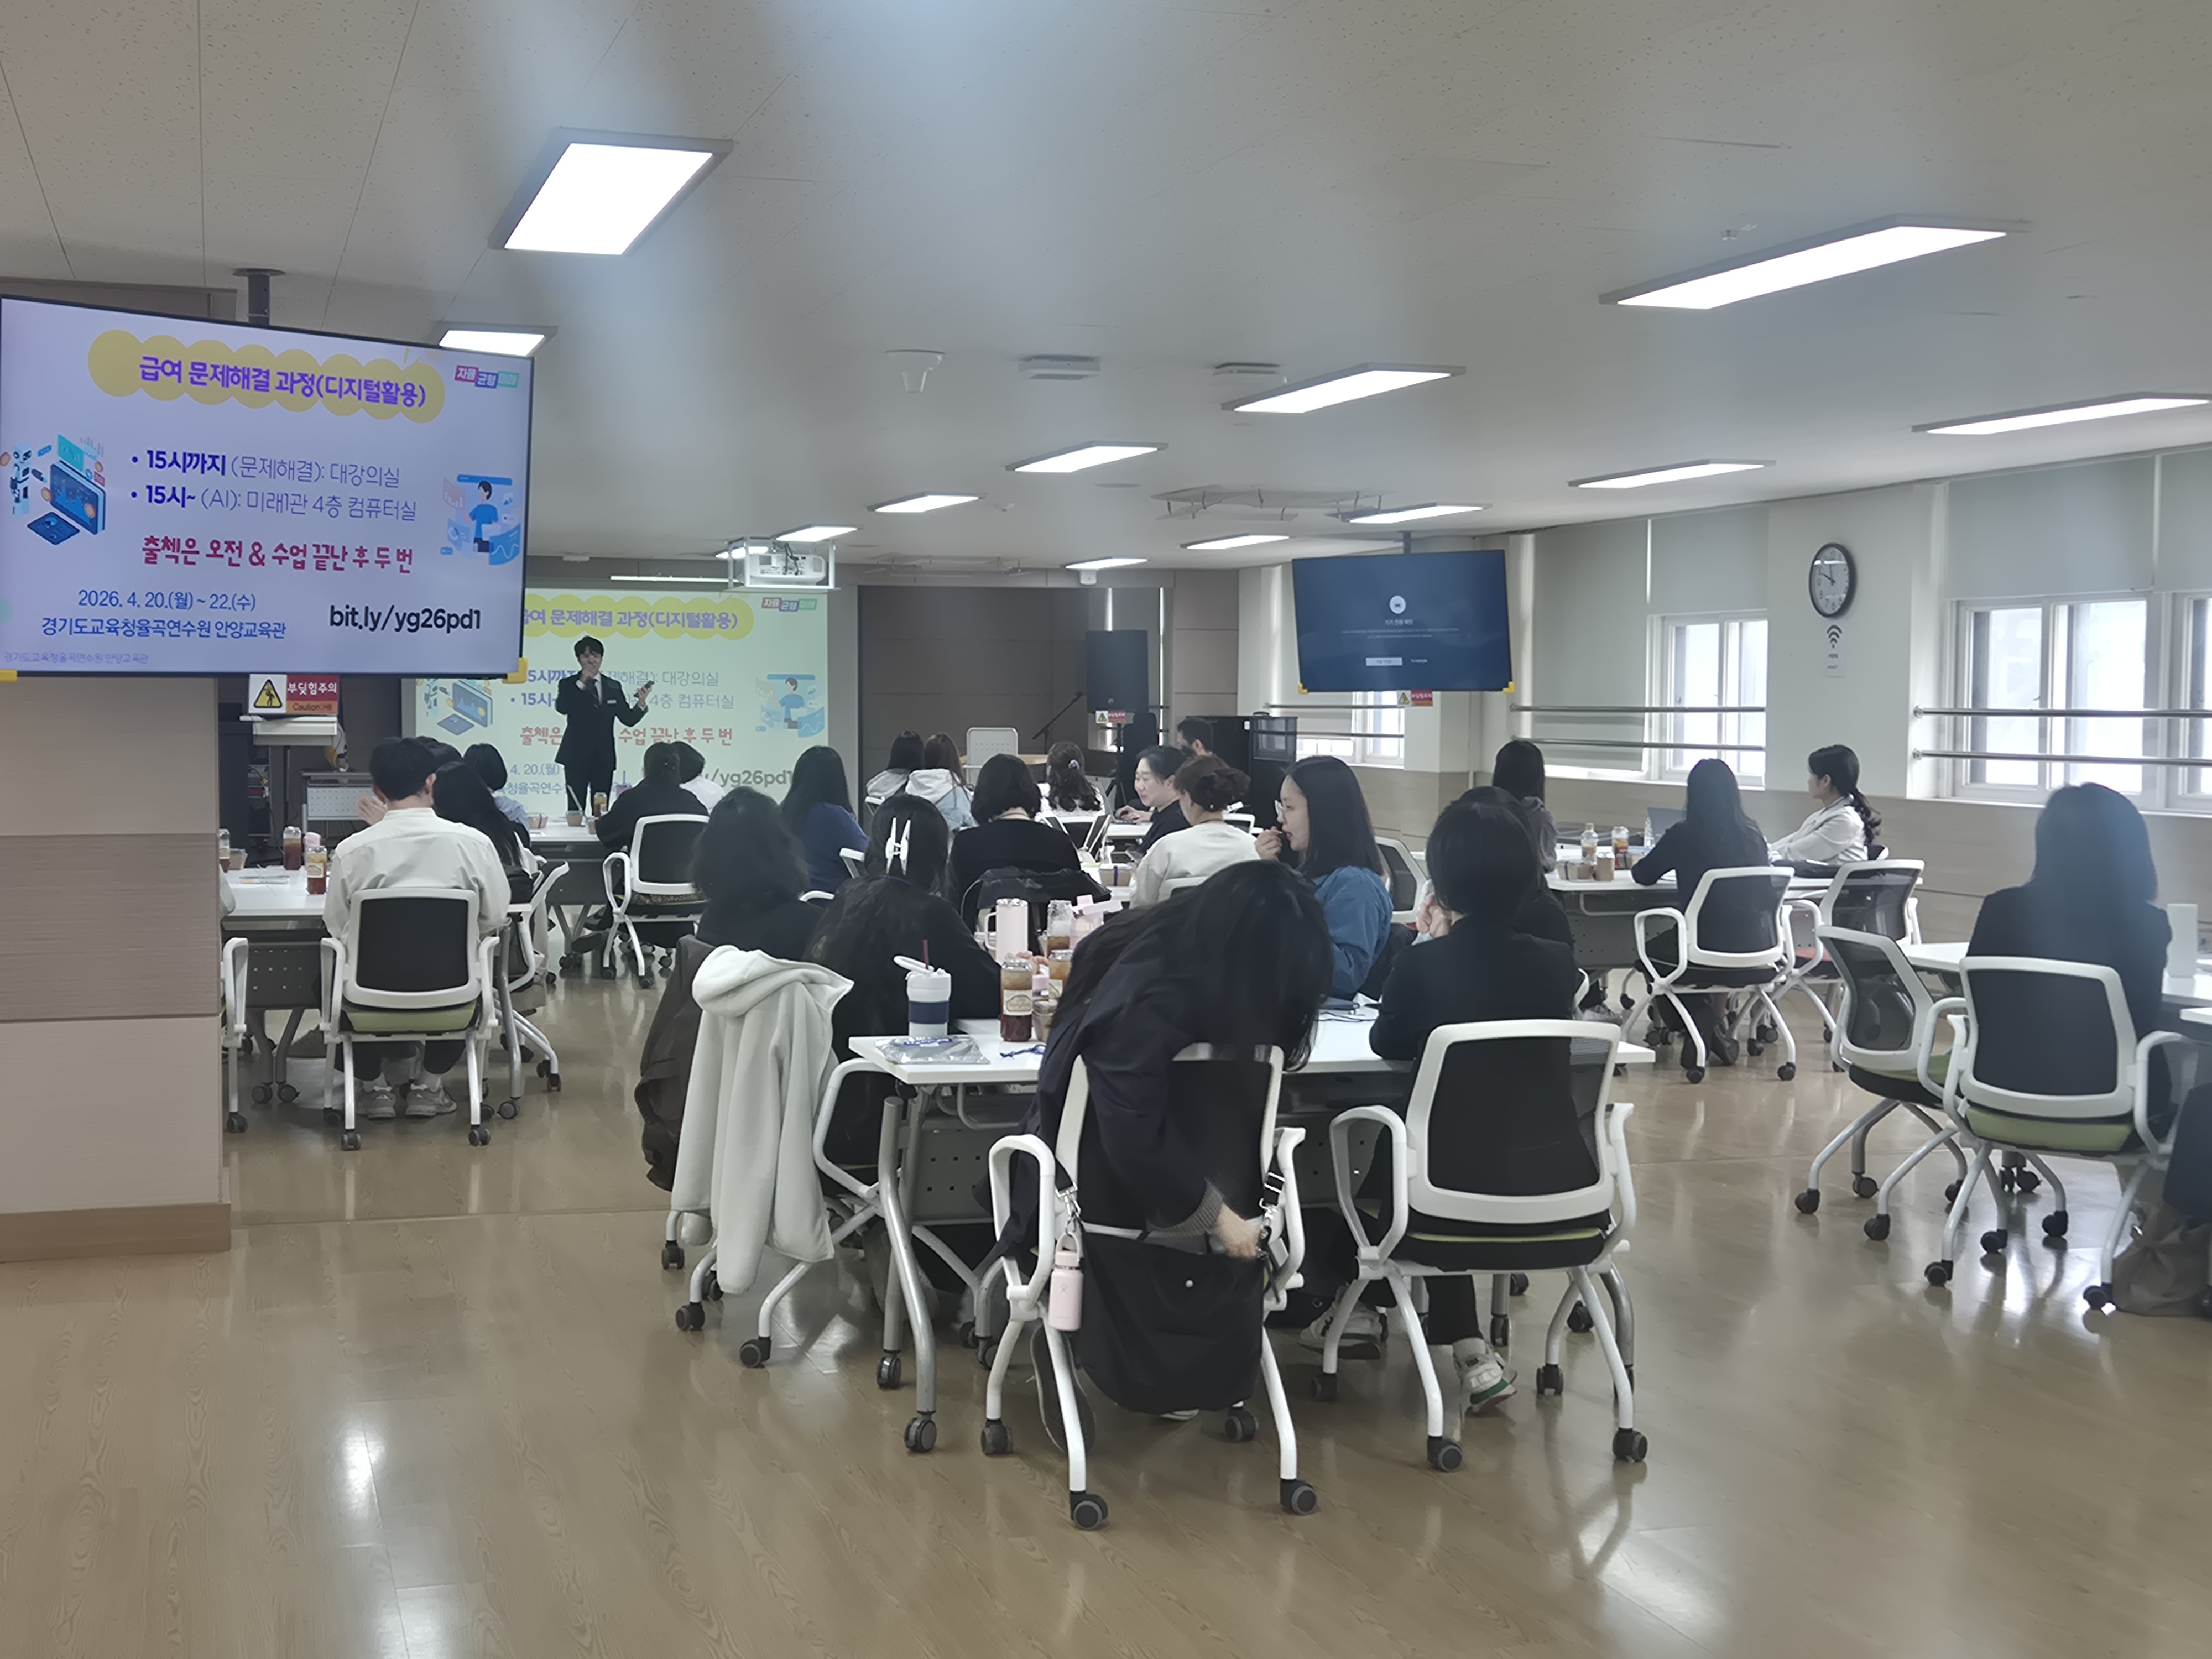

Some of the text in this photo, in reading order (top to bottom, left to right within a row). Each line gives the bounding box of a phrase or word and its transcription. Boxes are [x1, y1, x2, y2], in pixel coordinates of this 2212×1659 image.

[139, 356, 426, 408] 급여 문제해결 과정(디지털활용)
[457, 367, 476, 380] 자율
[477, 373, 497, 387] 균형
[147, 450, 399, 488] 15시까지 (문제해결): 대강의실
[145, 485, 416, 521] 15시~ (AI): 미래1관 4층 컴퓨터실
[142, 535, 412, 573] 출첵은 오전 & 수업 끝난 후 두 번
[78, 589, 123, 607] 2026.
[127, 592, 140, 608] 4.
[145, 591, 193, 611] 20.(월)
[209, 593, 255, 612] 22.(수)
[41, 617, 286, 639] 경기도교육청율곡연수원 안양교육관
[330, 604, 481, 634] bit.ly/yg26pd1
[550, 609, 613, 627] 문제해결
[617, 611, 738, 630] 과정(디지털활용)
[288, 682, 337, 695] 부딪힘주의
[662, 671, 719, 687] 대강의실
[649, 694, 673, 709] 4층
[678, 694, 734, 709] 컴퓨터실
[520, 726, 732, 746] 출첵은 수업 끝난 후 두 번
[510, 763, 560, 775] 4. 20.(월)
